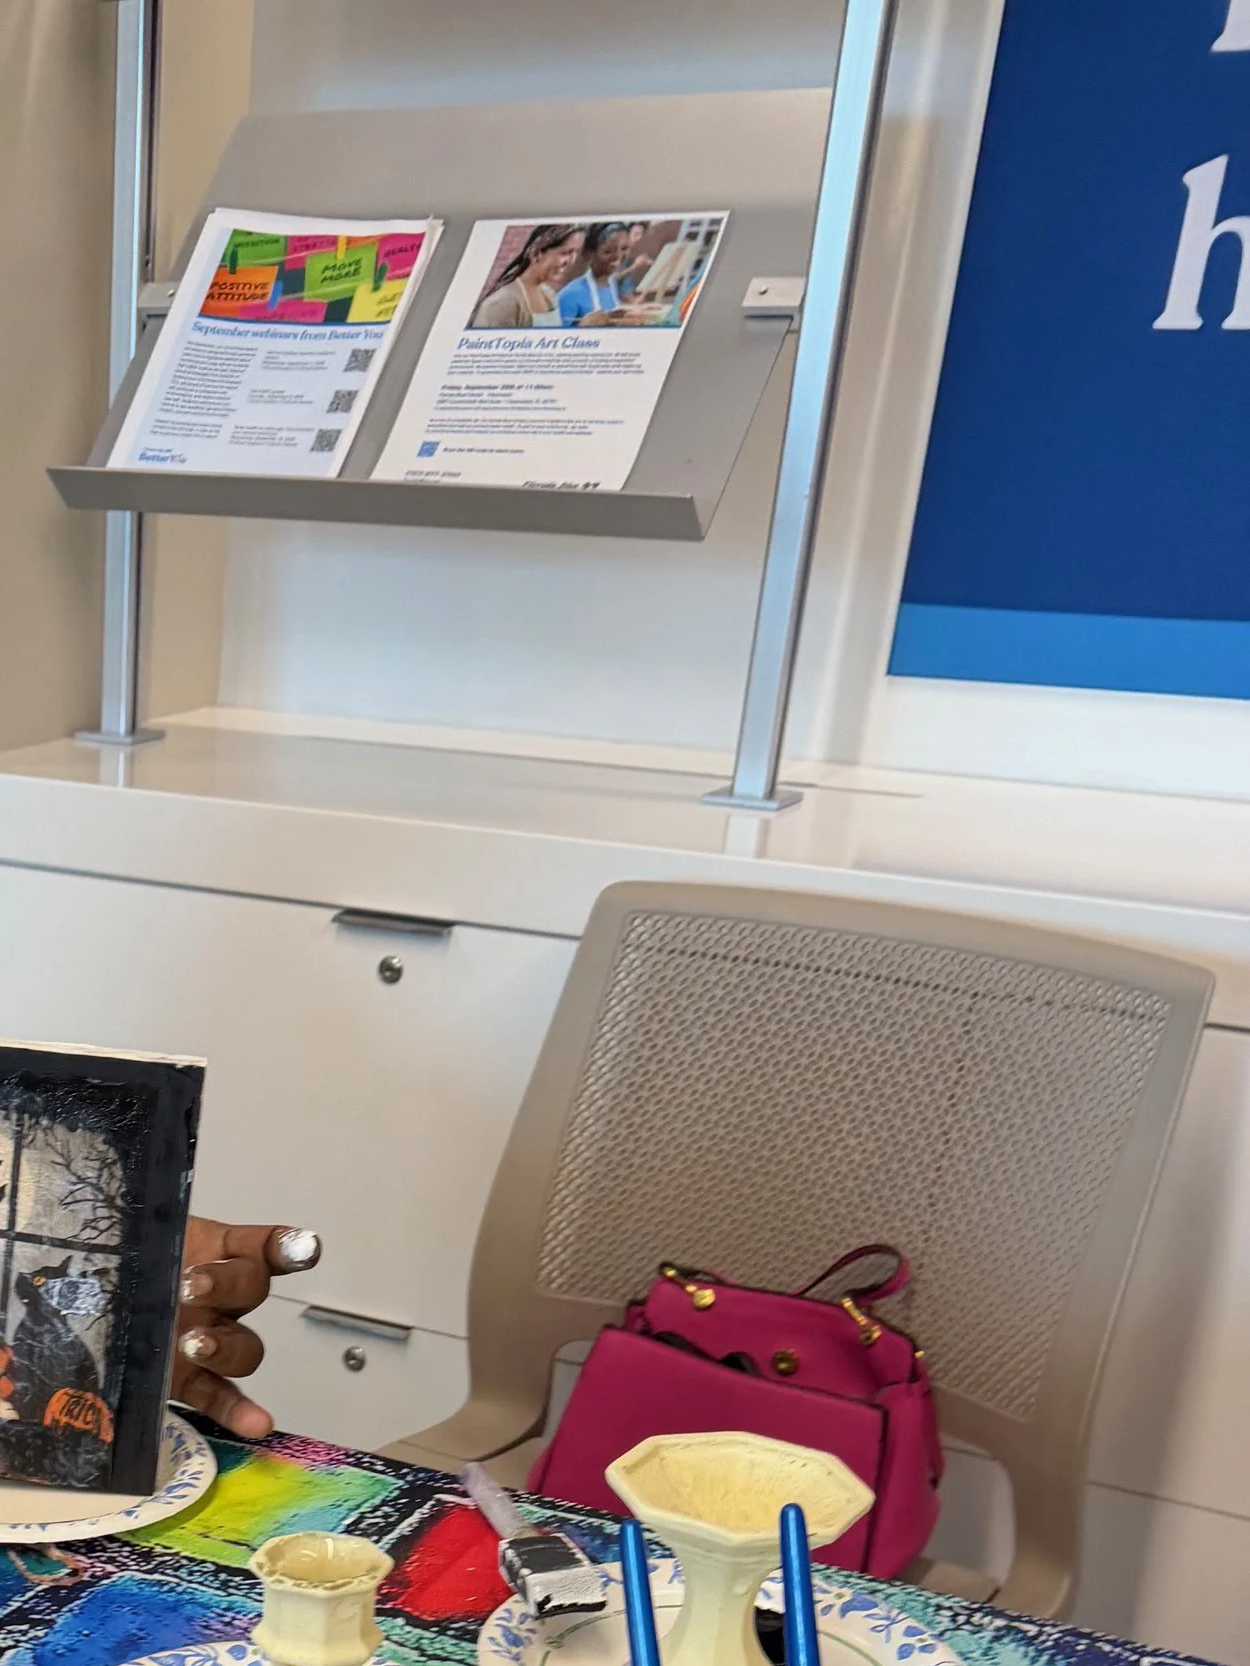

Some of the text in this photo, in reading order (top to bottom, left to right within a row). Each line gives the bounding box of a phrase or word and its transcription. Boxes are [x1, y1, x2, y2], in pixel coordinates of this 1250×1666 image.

[321, 257, 363, 274] MOVE
[209, 281, 269, 292] POSITIVE
[206, 292, 268, 301] ATTITUDE
[191, 320, 385, 342] September webinars from Better You
[457, 336, 601, 352] PaintTopia Art Class
